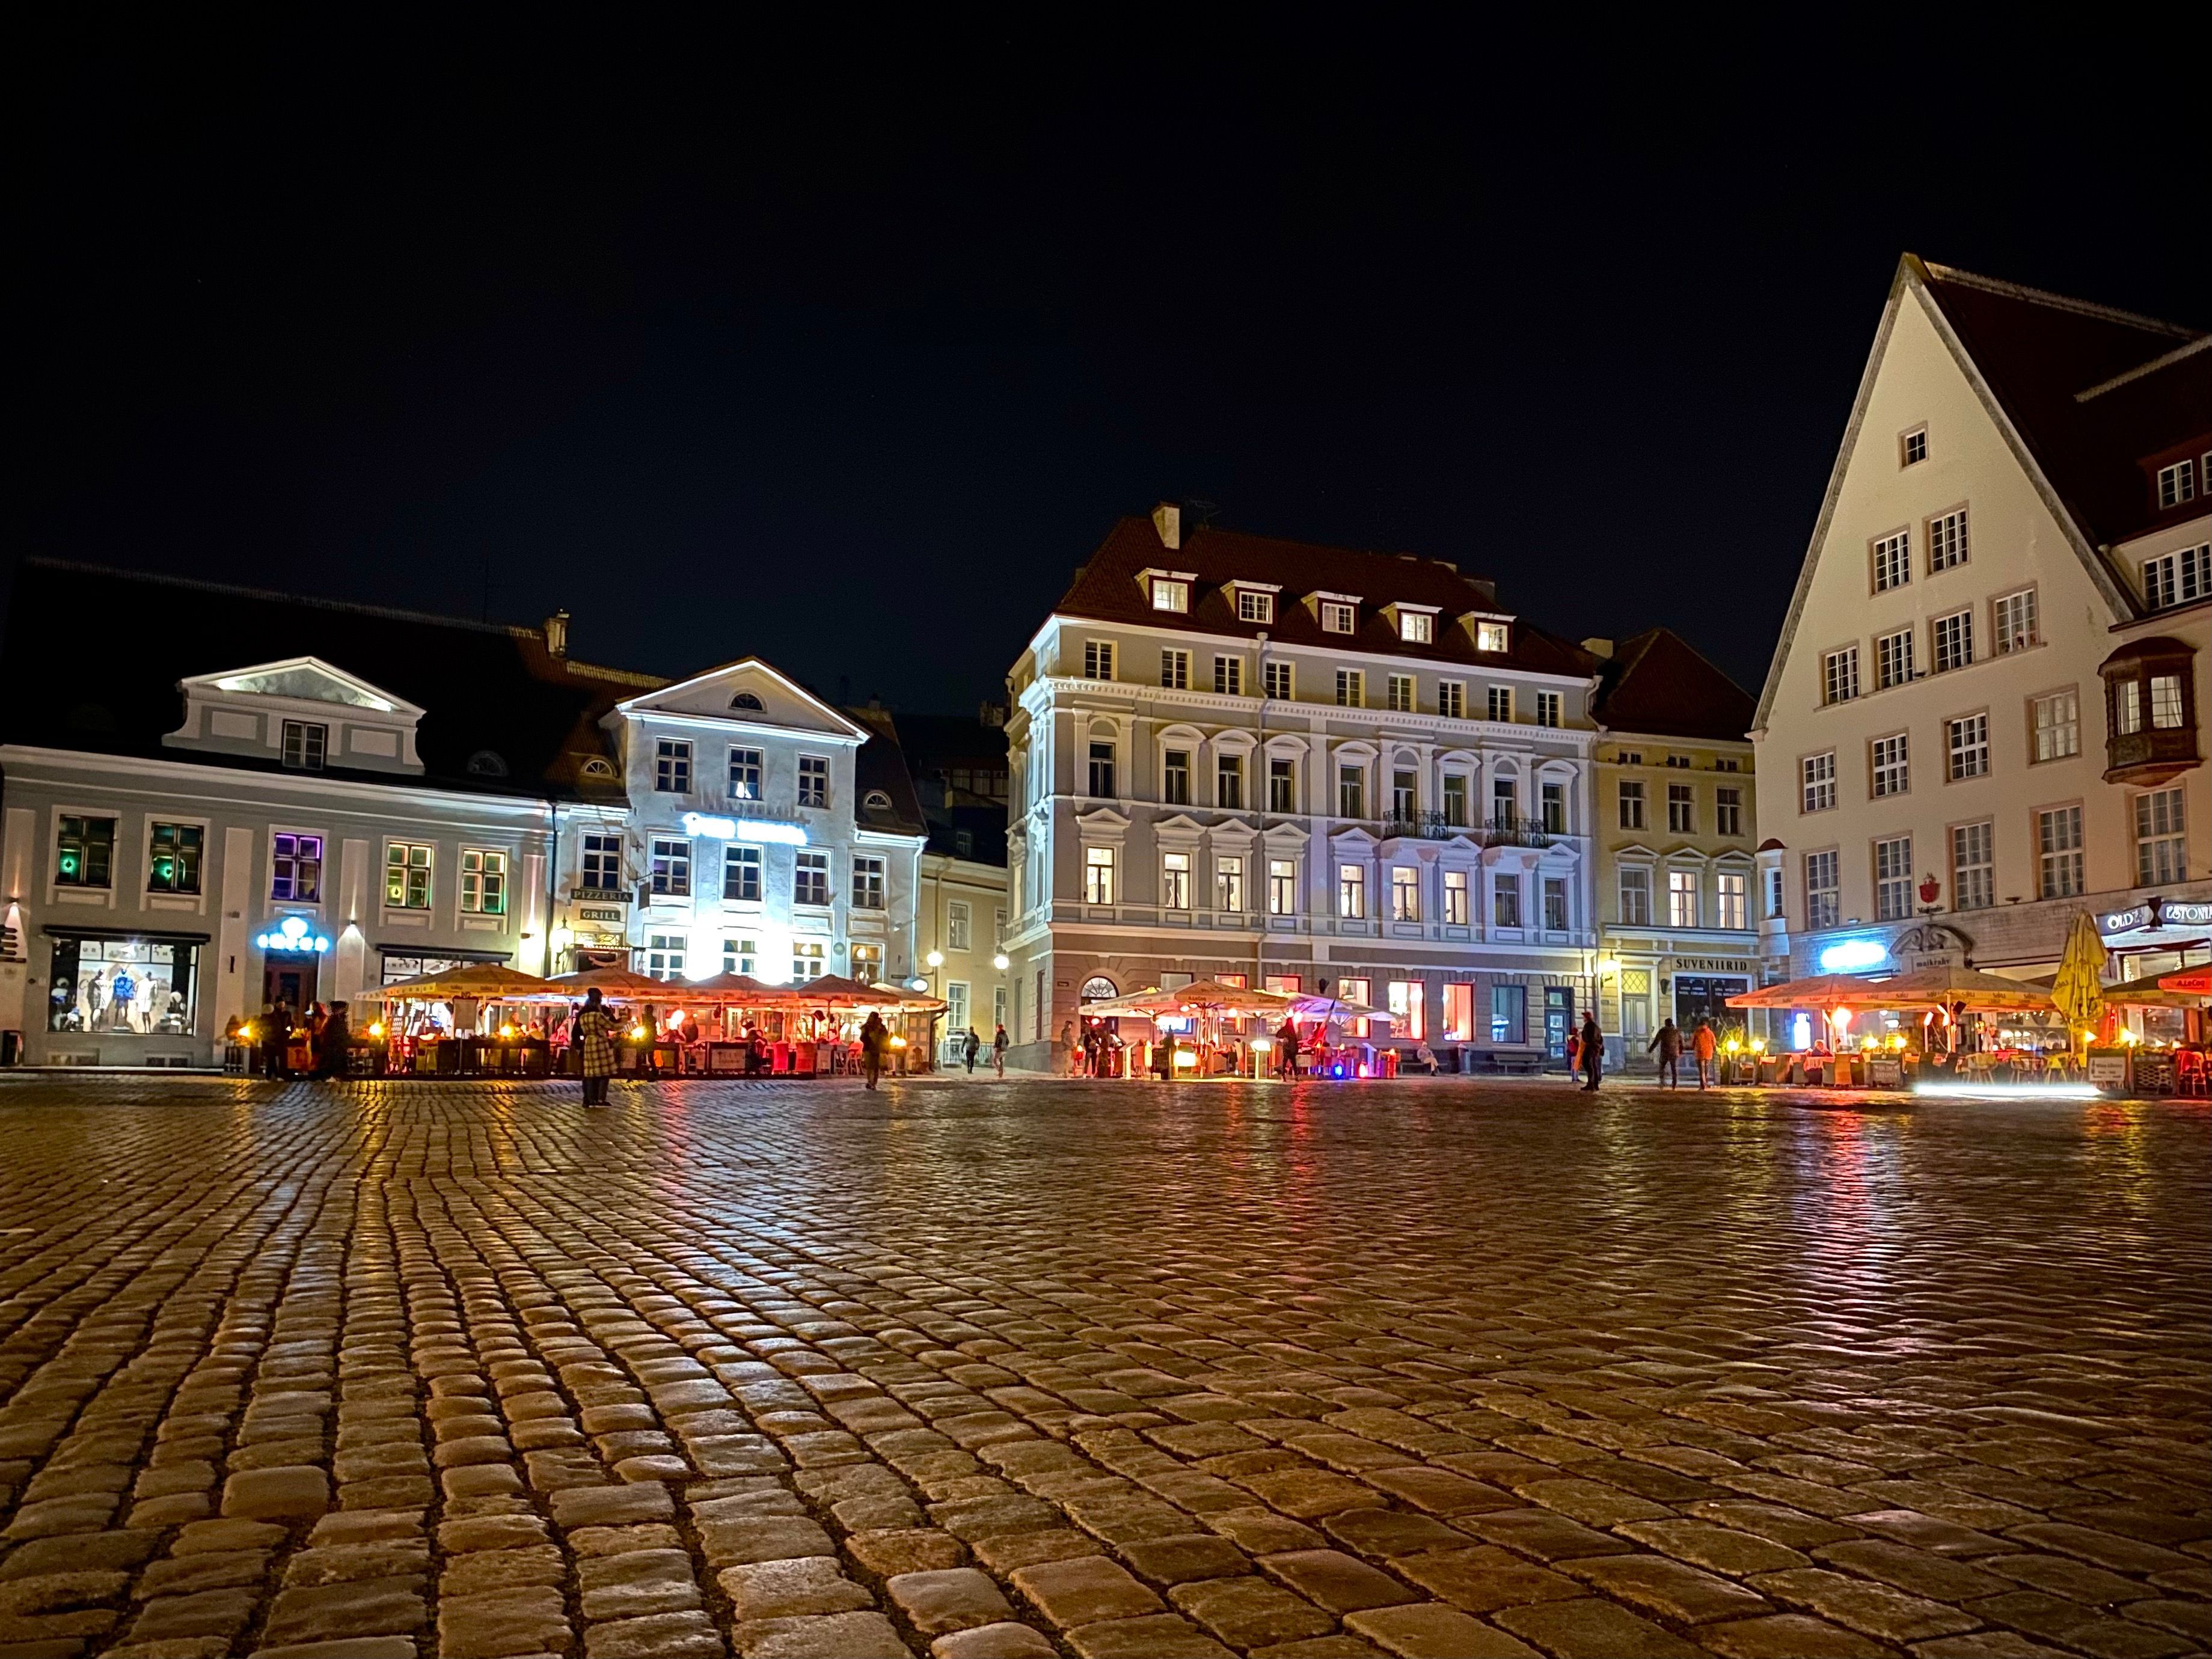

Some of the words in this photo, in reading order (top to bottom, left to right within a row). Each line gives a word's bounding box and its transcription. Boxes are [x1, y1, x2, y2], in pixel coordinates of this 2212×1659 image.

[574, 891, 630, 901] PIZZERIA
[583, 910, 618, 920] GRILL
[1676, 958, 1747, 971] SUVENIIRID
